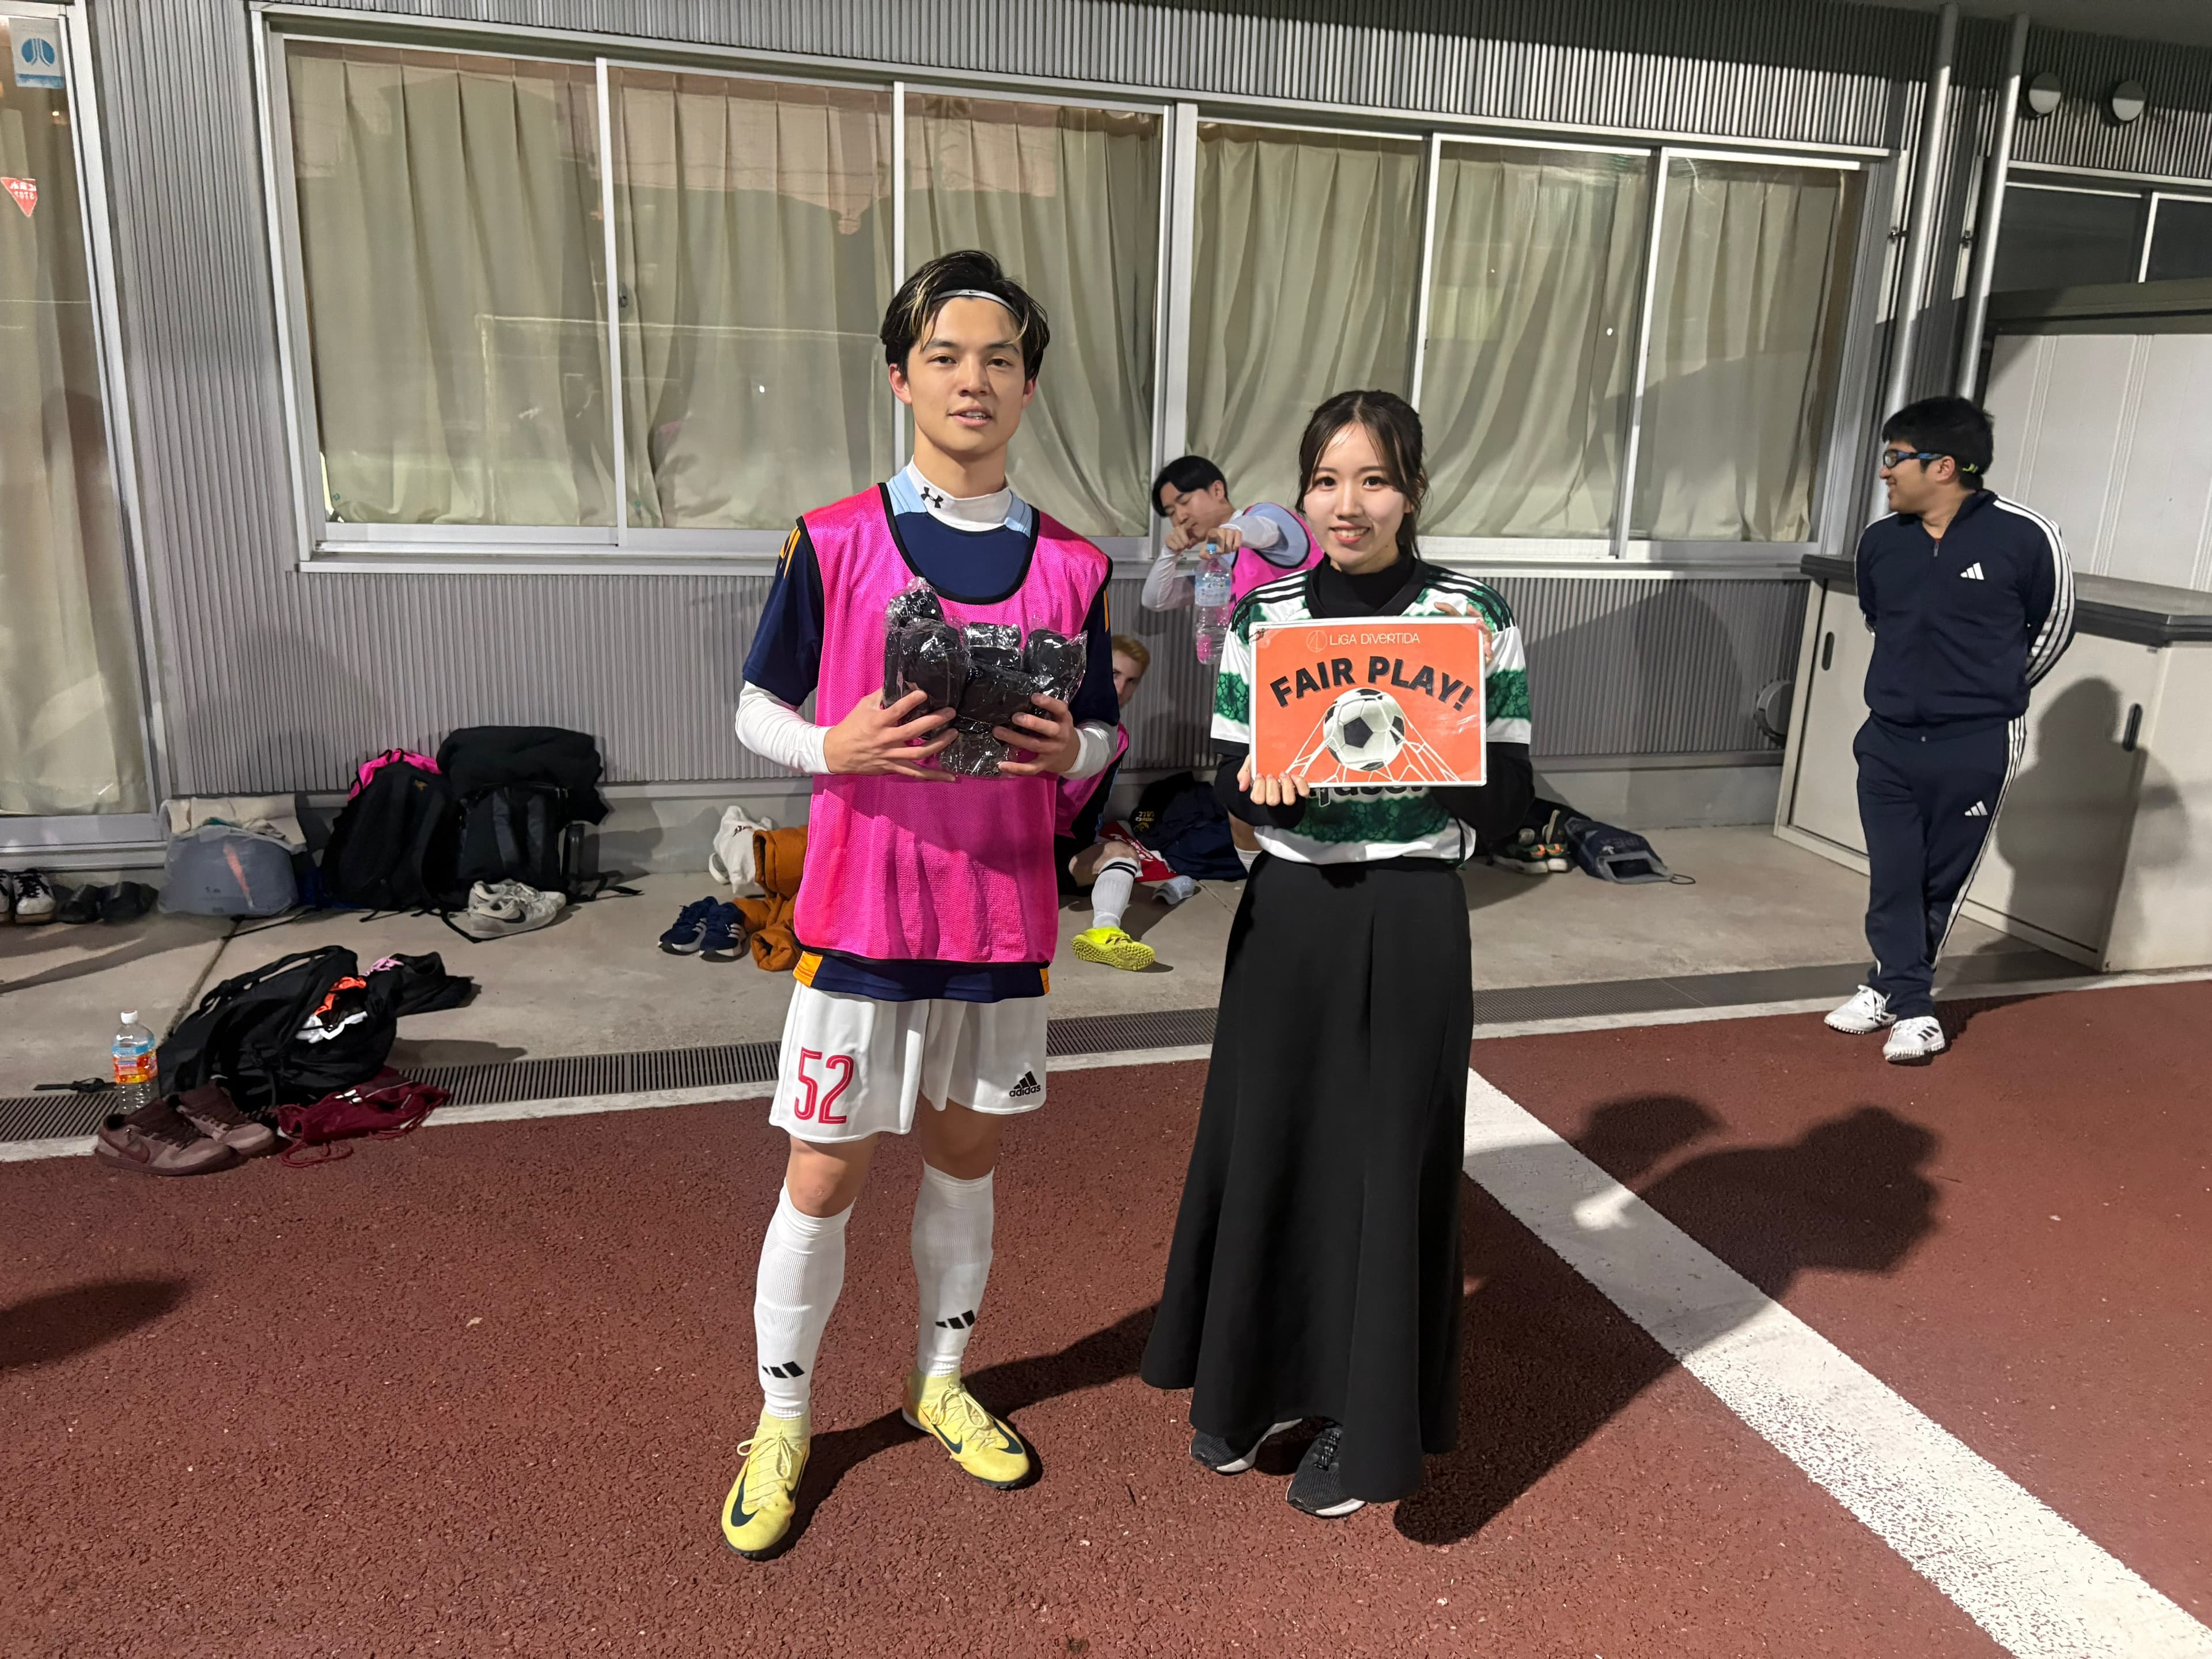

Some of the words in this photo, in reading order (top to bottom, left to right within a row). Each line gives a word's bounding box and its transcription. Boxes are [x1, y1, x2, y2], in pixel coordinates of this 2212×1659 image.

[1270, 658, 1355, 708] FAIR
[1368, 656, 1475, 711] PLAY!
[794, 1046, 854, 1124] 52
[1009, 1085, 1041, 1097] adidas
